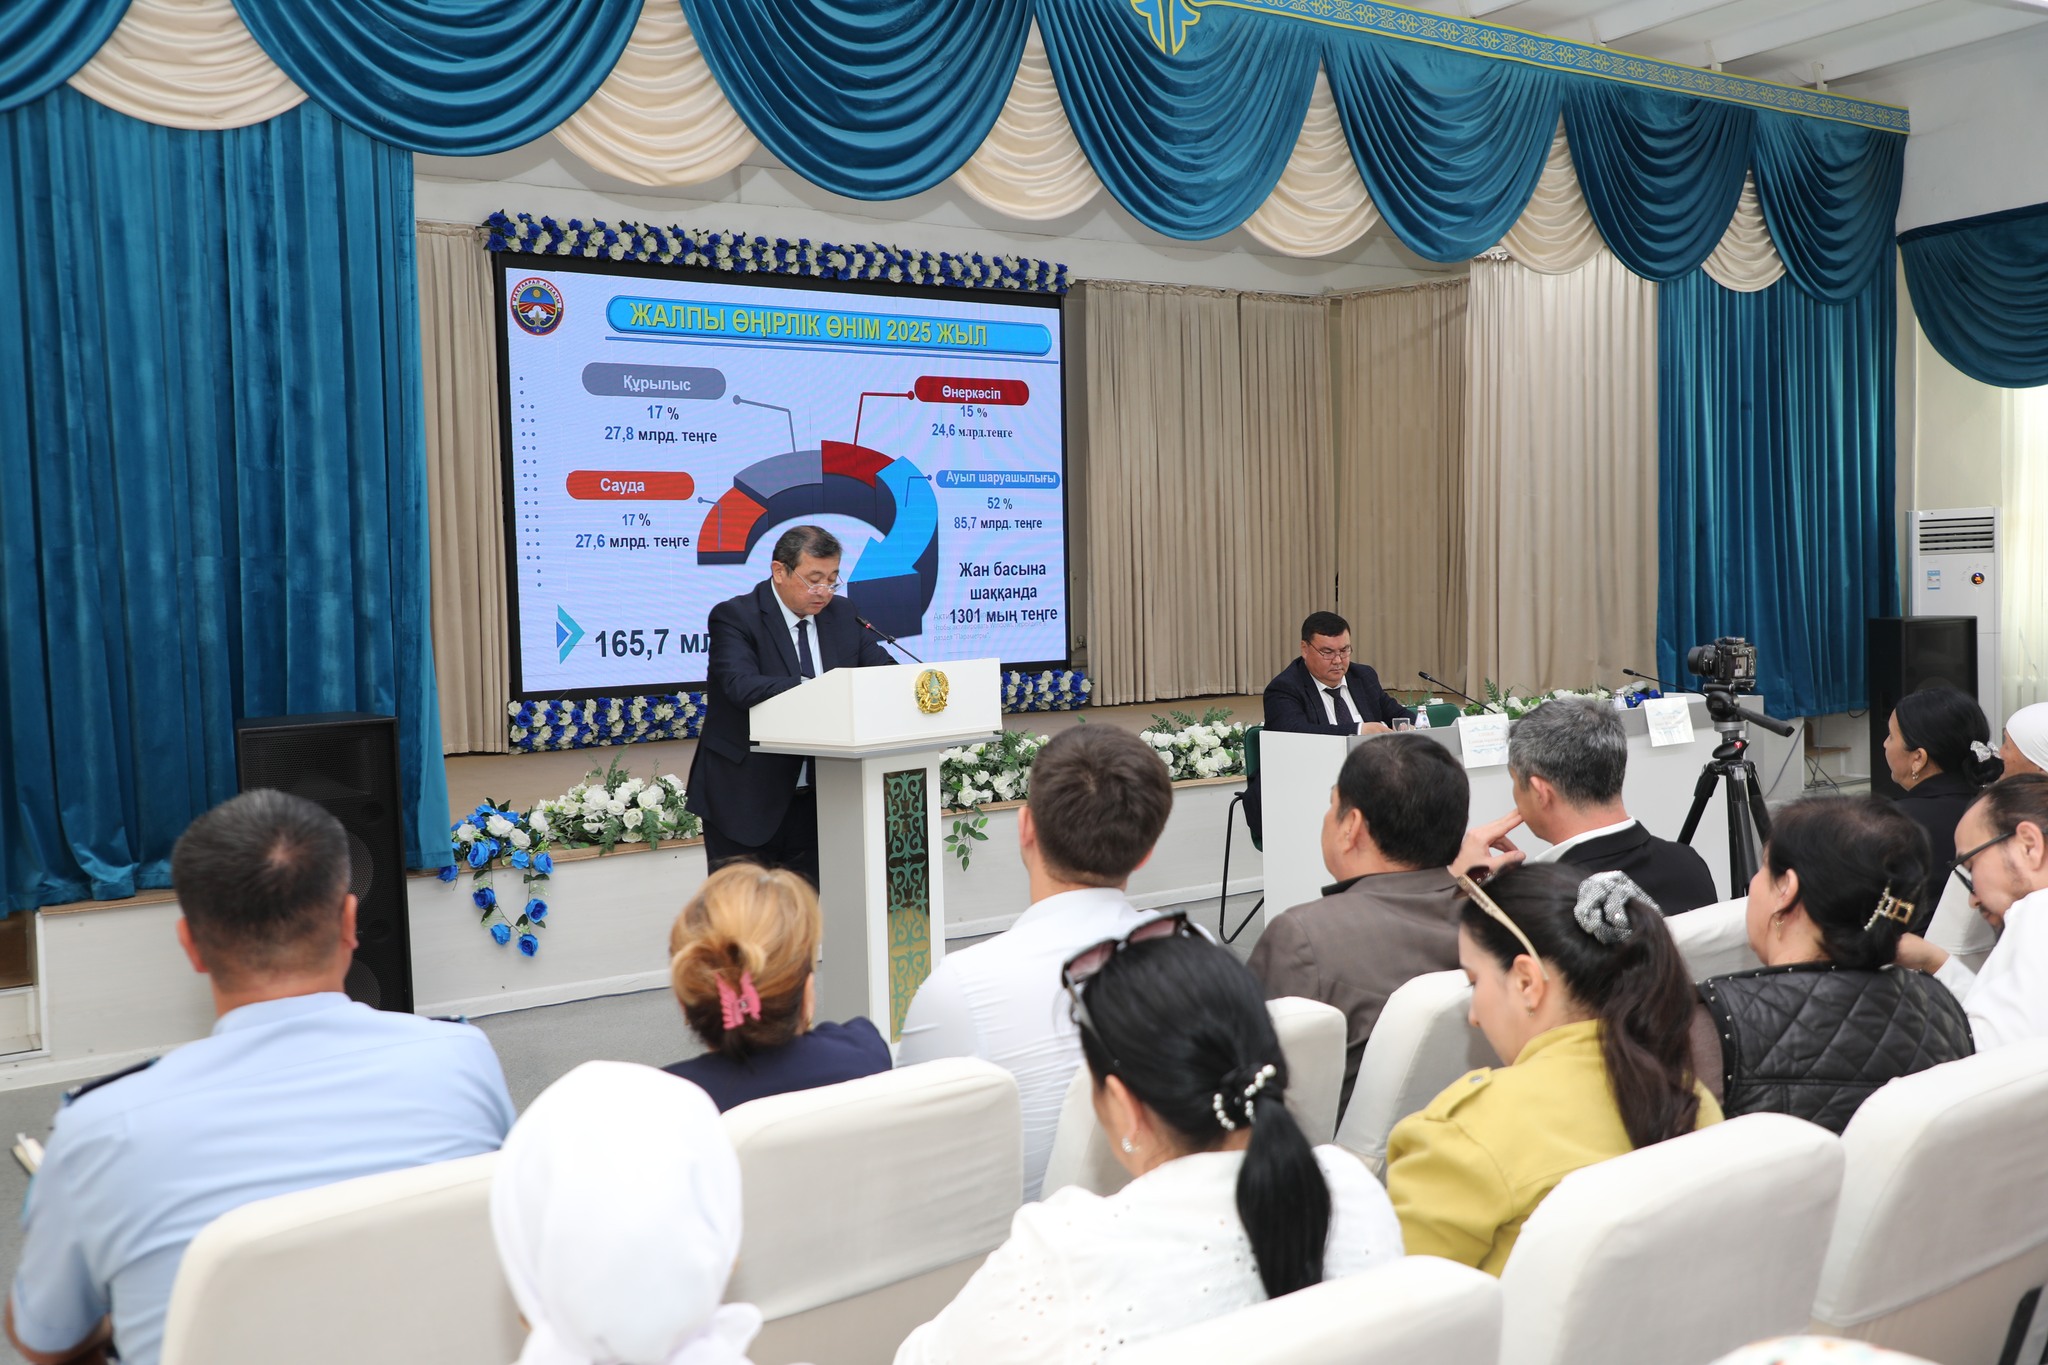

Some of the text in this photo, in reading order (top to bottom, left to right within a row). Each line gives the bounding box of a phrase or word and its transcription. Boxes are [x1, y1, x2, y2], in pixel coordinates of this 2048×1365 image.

[629, 302, 987, 346] ЖАЛПЫ ӨҢІРЛІК ӨНІМ 2025 ЖЫЛ
[623, 374, 691, 393] Құрылыс
[942, 385, 1001, 401] Өнеркәсіп
[647, 404, 679, 420] 17 %
[960, 405, 988, 418] 15 %
[604, 426, 717, 444] 27,8 млрд. теңге
[932, 423, 956, 438] 24,6
[600, 477, 645, 495] Сауда
[946, 471, 1056, 486] Ауыл шаруашылығы
[987, 497, 1013, 510] 52 %
[622, 513, 651, 526] 17 %
[954, 516, 1043, 531] 85,7 млрд. теңге
[575, 534, 690, 550] 27,6 млрд. теңге
[959, 561, 1046, 577] Жан басына
[970, 586, 1037, 602] шаққанда
[950, 608, 980, 624] 1301
[986, 610, 1018, 623] мың
[1021, 608, 1058, 622] теңге
[595, 628, 711, 660] 165,7 мл
